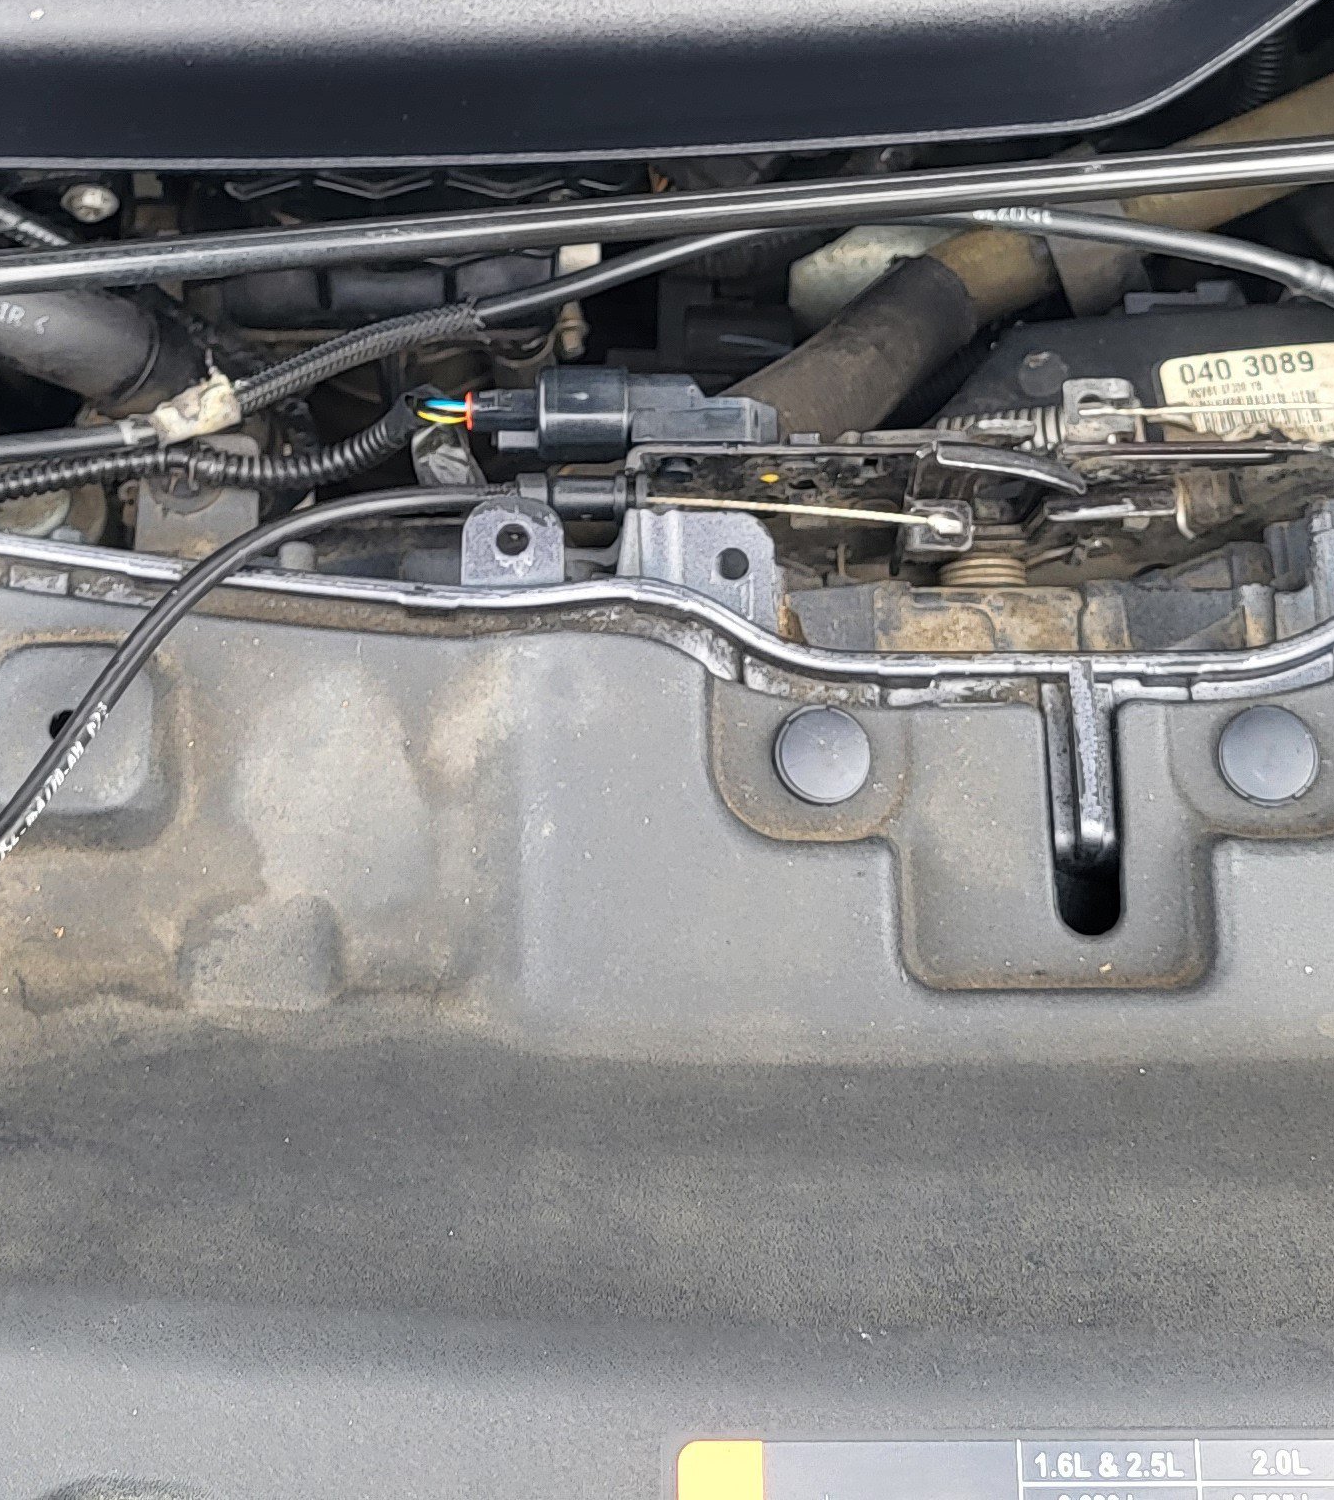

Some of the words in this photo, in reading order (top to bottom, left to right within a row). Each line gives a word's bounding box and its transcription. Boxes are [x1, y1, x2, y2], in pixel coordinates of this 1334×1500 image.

[1179, 358, 1232, 385] 040
[1243, 350, 1315, 378] 3089
[1033, 1451, 1093, 1479] 1.6L
[1098, 1451, 1121, 1479] &
[1125, 1451, 1185, 1479] 2.5L
[1251, 1448, 1312, 1477] 2.0L
